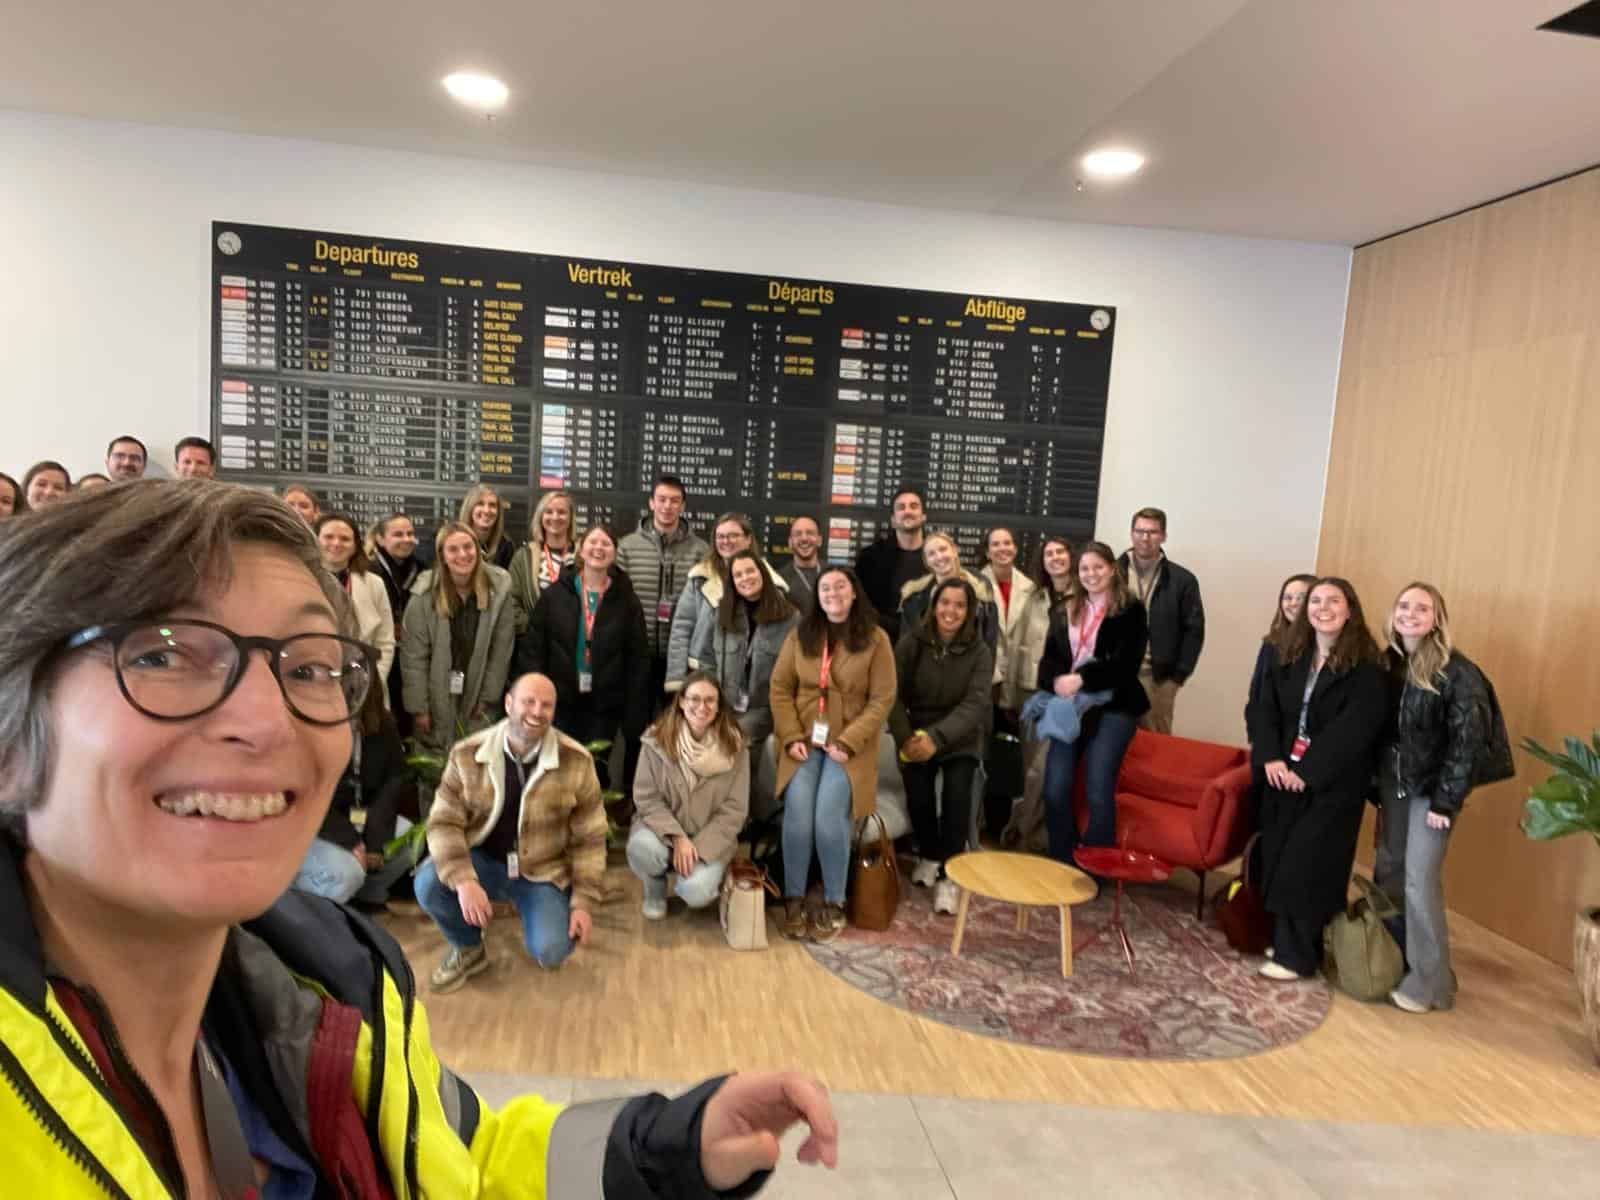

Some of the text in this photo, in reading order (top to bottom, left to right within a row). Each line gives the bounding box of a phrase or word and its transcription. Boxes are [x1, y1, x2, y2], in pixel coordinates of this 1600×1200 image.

[314, 240, 419, 269] Departures
[568, 263, 632, 287] Vertrek
[768, 281, 835, 305] Départs
[964, 298, 1026, 323] Abflüge
[376, 312, 408, 323] LISBON
[376, 323, 422, 335] FRANKFURT
[376, 335, 398, 344] LYON
[376, 357, 428, 368] COPENHAGEN
[376, 393, 422, 405] BARCELONA
[684, 487, 726, 497] ASABLANCA
